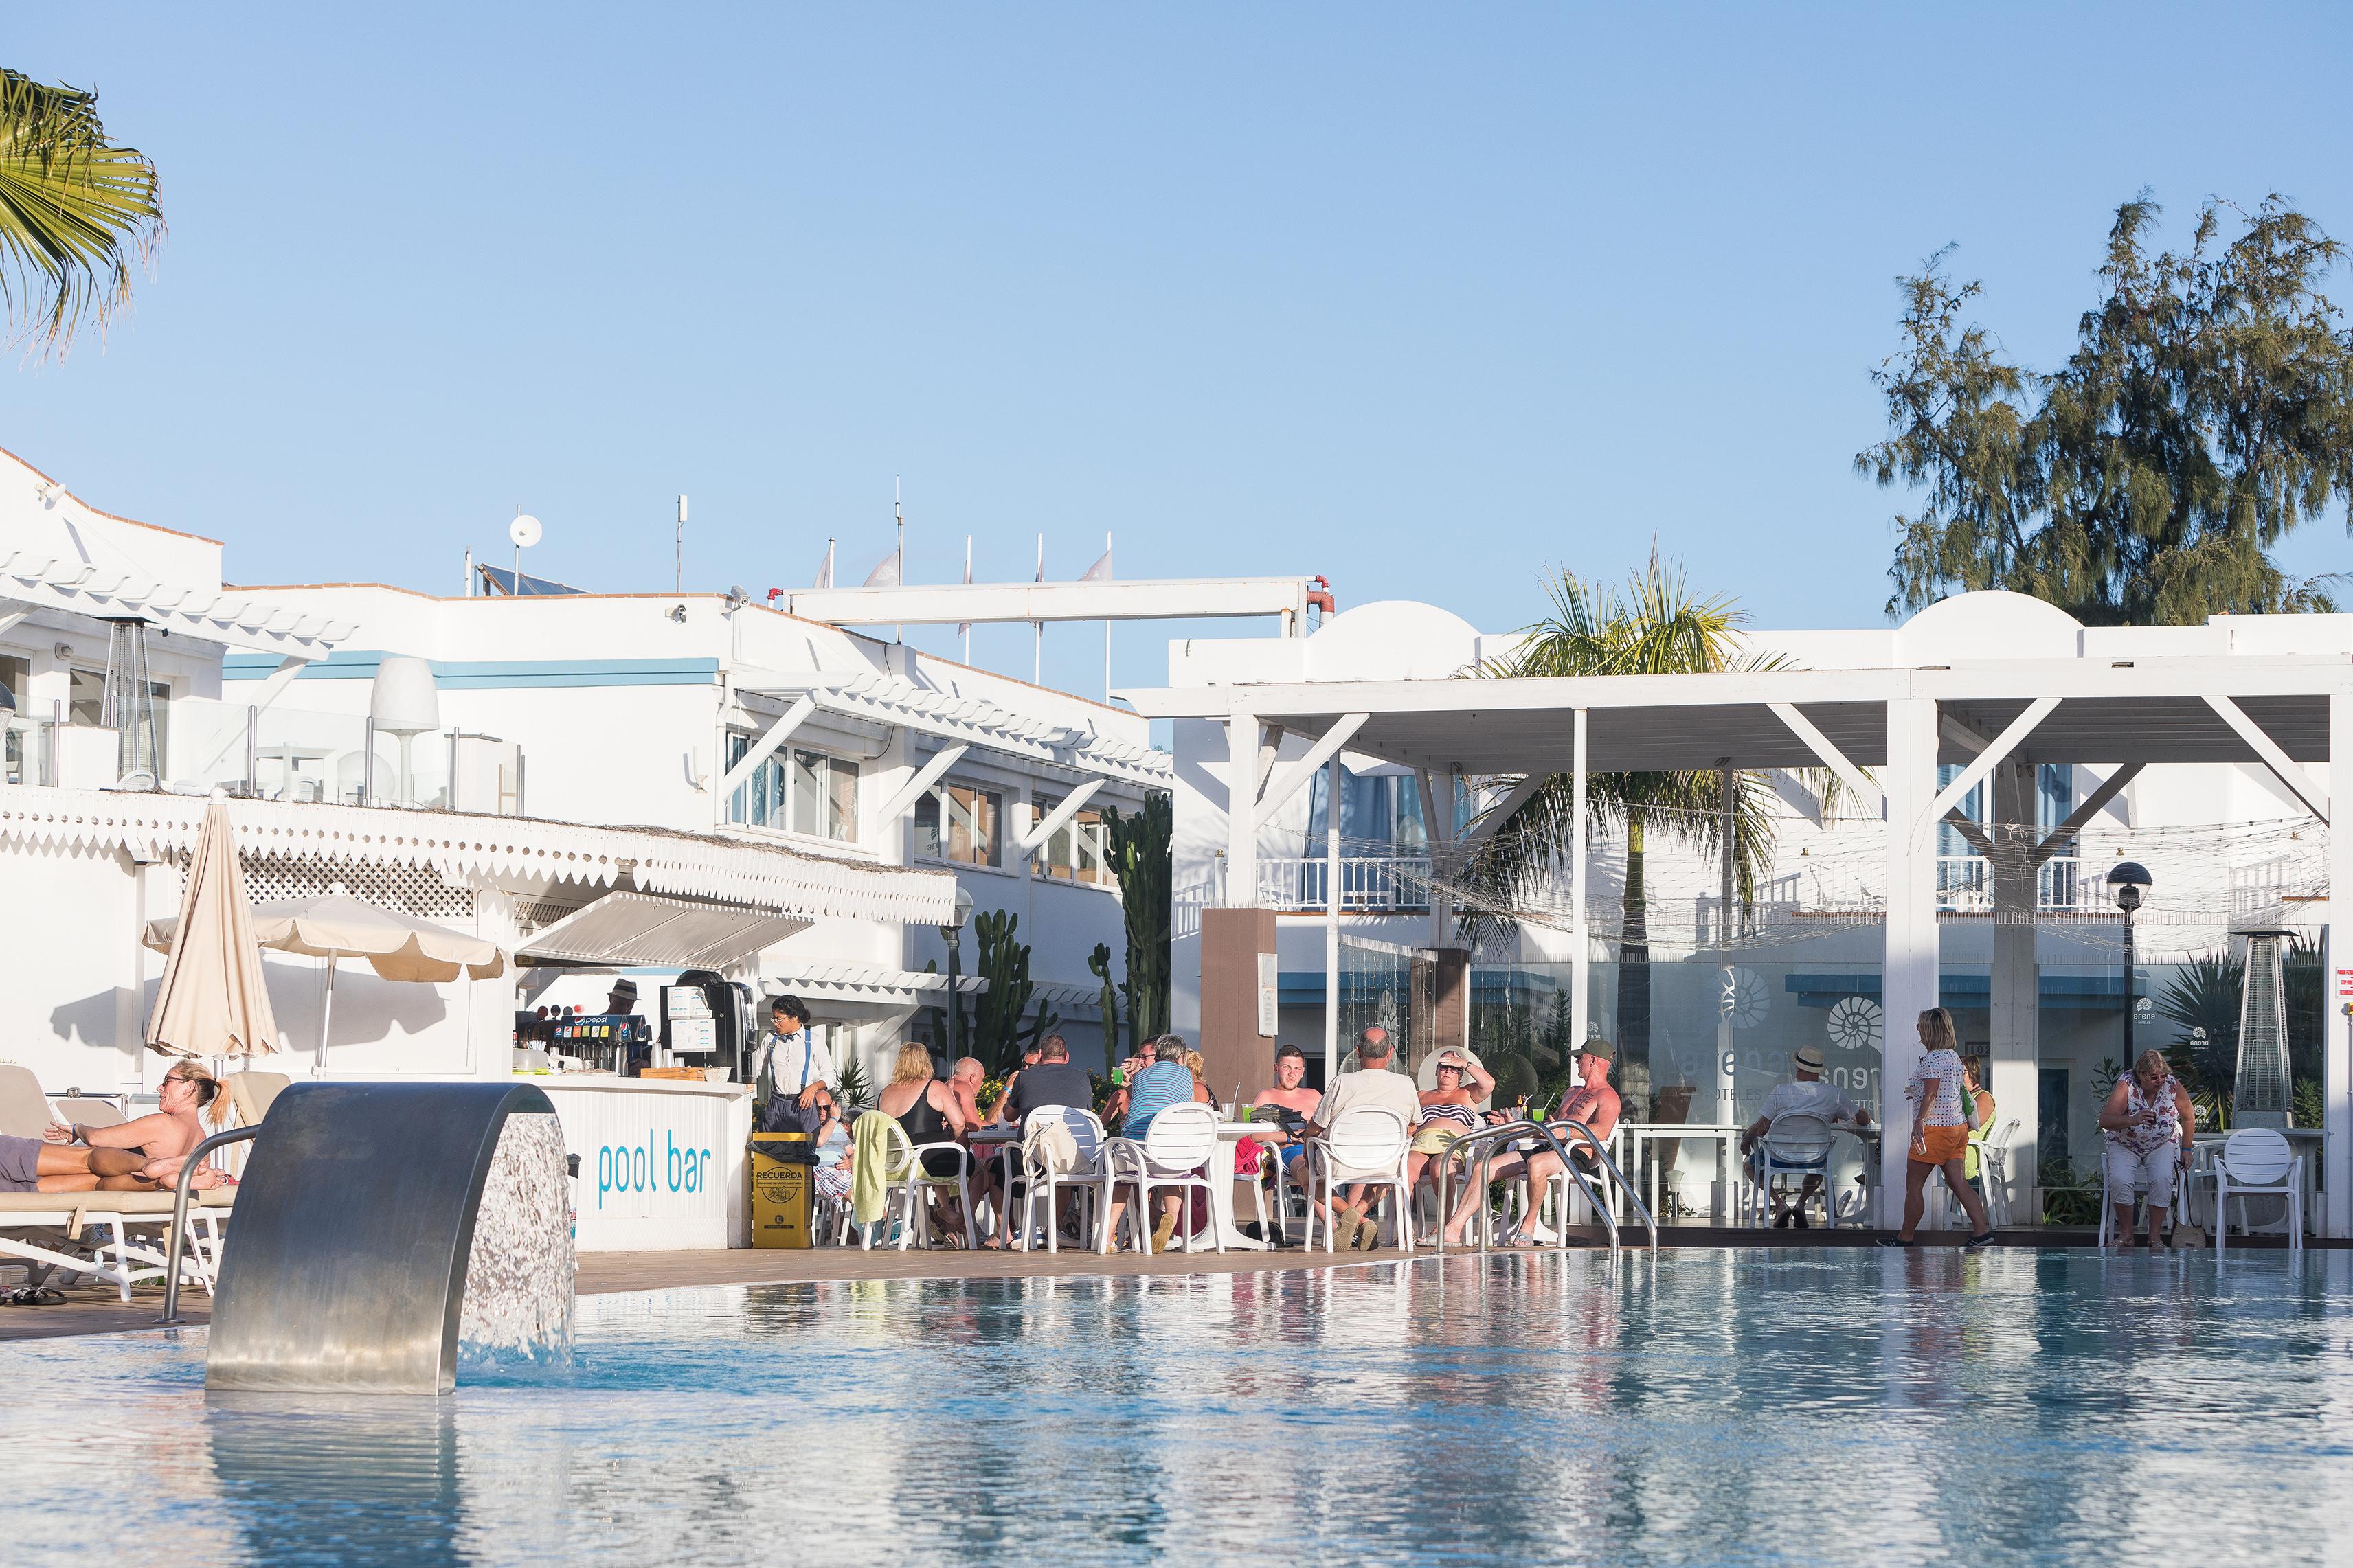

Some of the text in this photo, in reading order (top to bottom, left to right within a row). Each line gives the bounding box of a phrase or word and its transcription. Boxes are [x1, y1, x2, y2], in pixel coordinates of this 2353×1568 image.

[1703, 1088, 1761, 1100] HOTELES
[599, 1128, 711, 1210] pool bar
